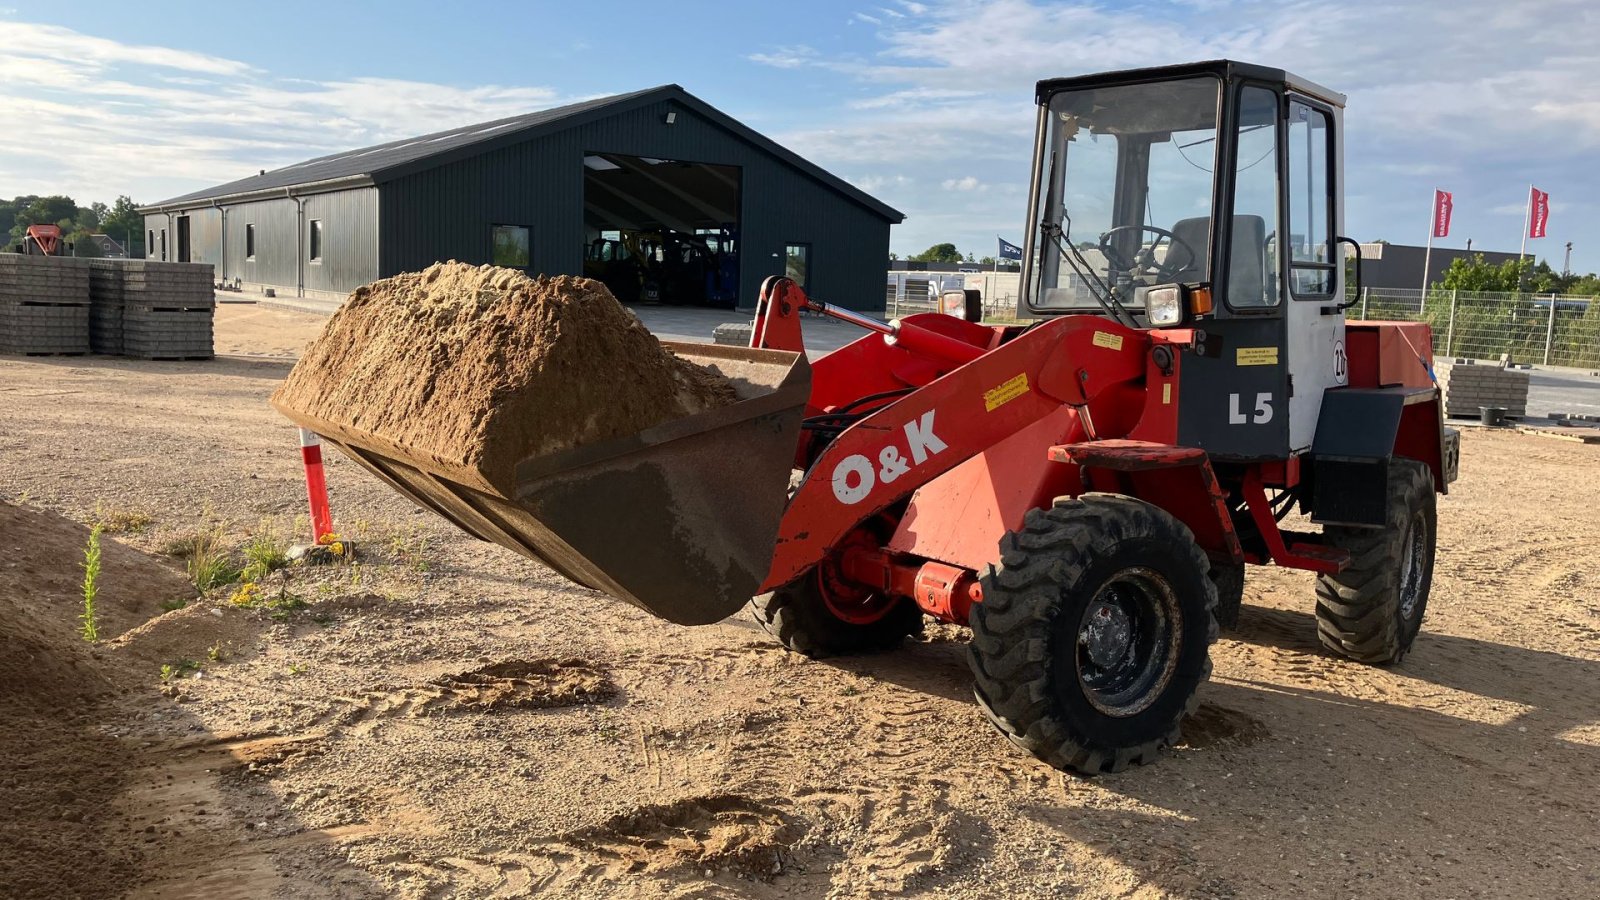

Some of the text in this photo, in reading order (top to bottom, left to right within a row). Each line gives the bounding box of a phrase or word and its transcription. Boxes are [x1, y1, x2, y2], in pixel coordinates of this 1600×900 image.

[1229, 392, 1273, 425] L 5
[831, 408, 949, 505] O&K
